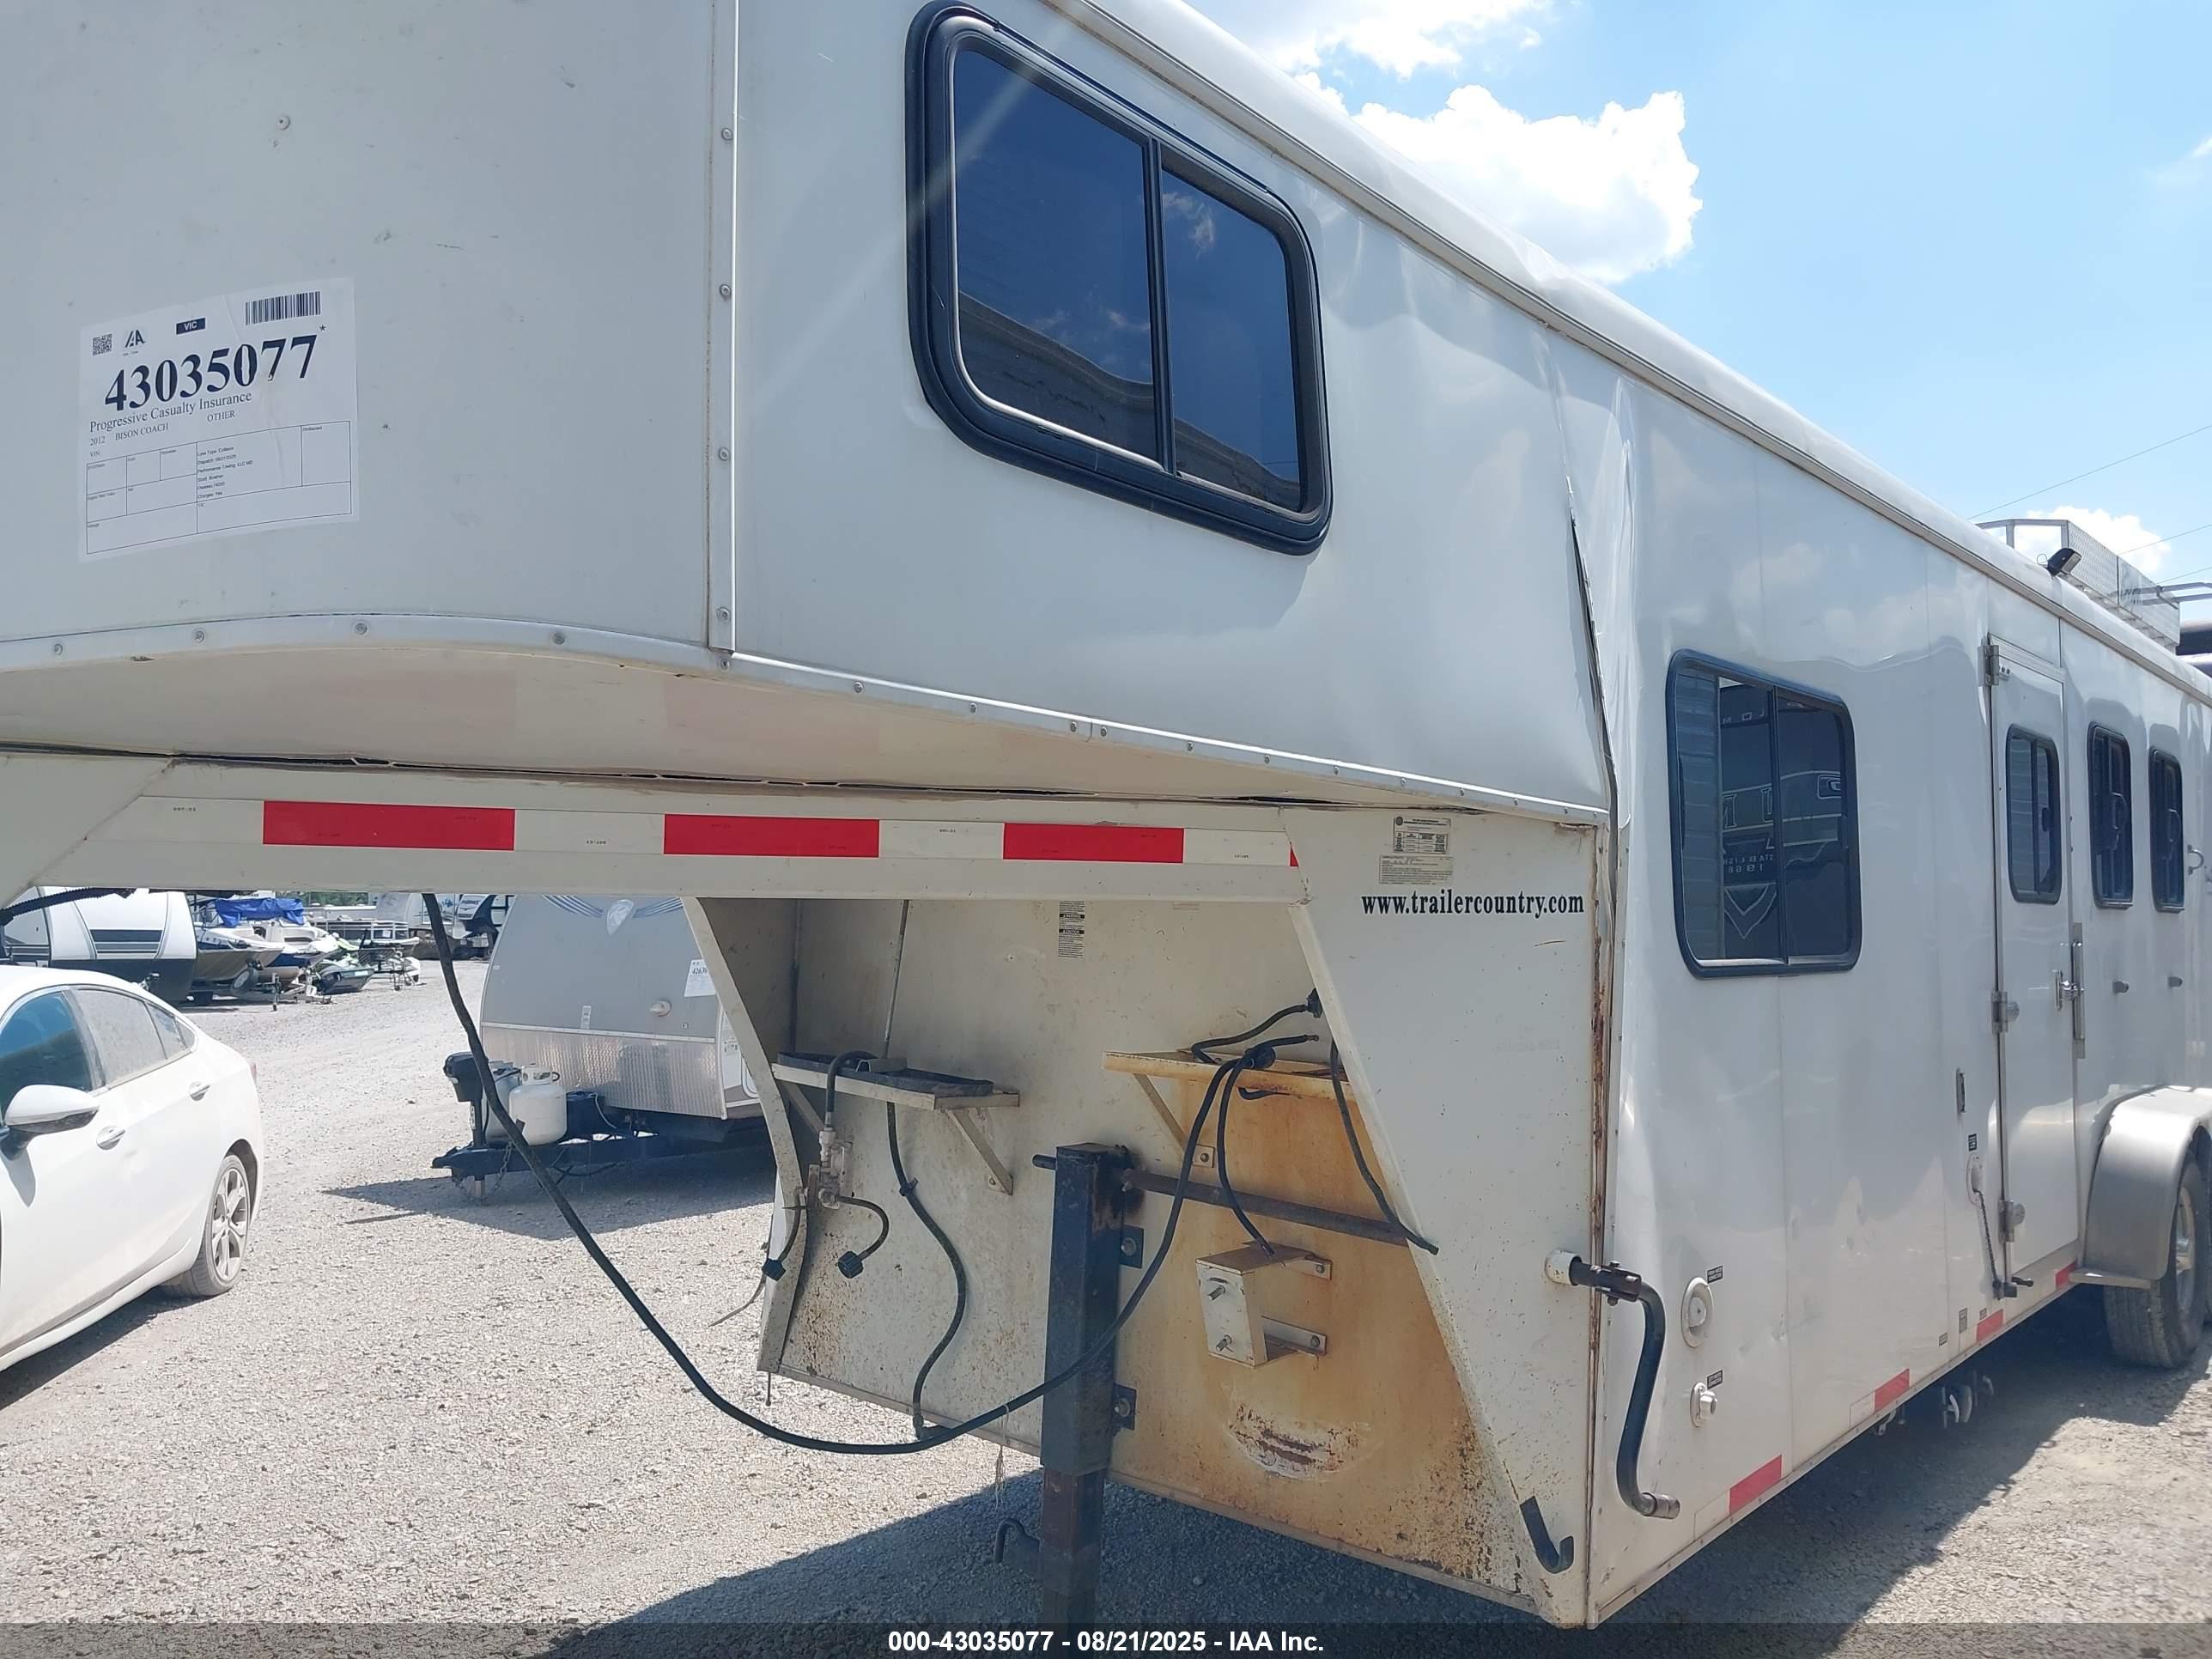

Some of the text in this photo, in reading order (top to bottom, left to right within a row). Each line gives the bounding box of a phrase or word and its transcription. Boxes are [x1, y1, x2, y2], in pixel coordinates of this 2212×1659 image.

[184, 321, 198, 331] VIC
[105, 334, 317, 410] 43035077
[89, 392, 252, 433] Progressive Casualty Insurance
[90, 410, 235, 446] 2012 BISON COACH OTHER
[1361, 889, 1585, 919] www.trailercountry.com
